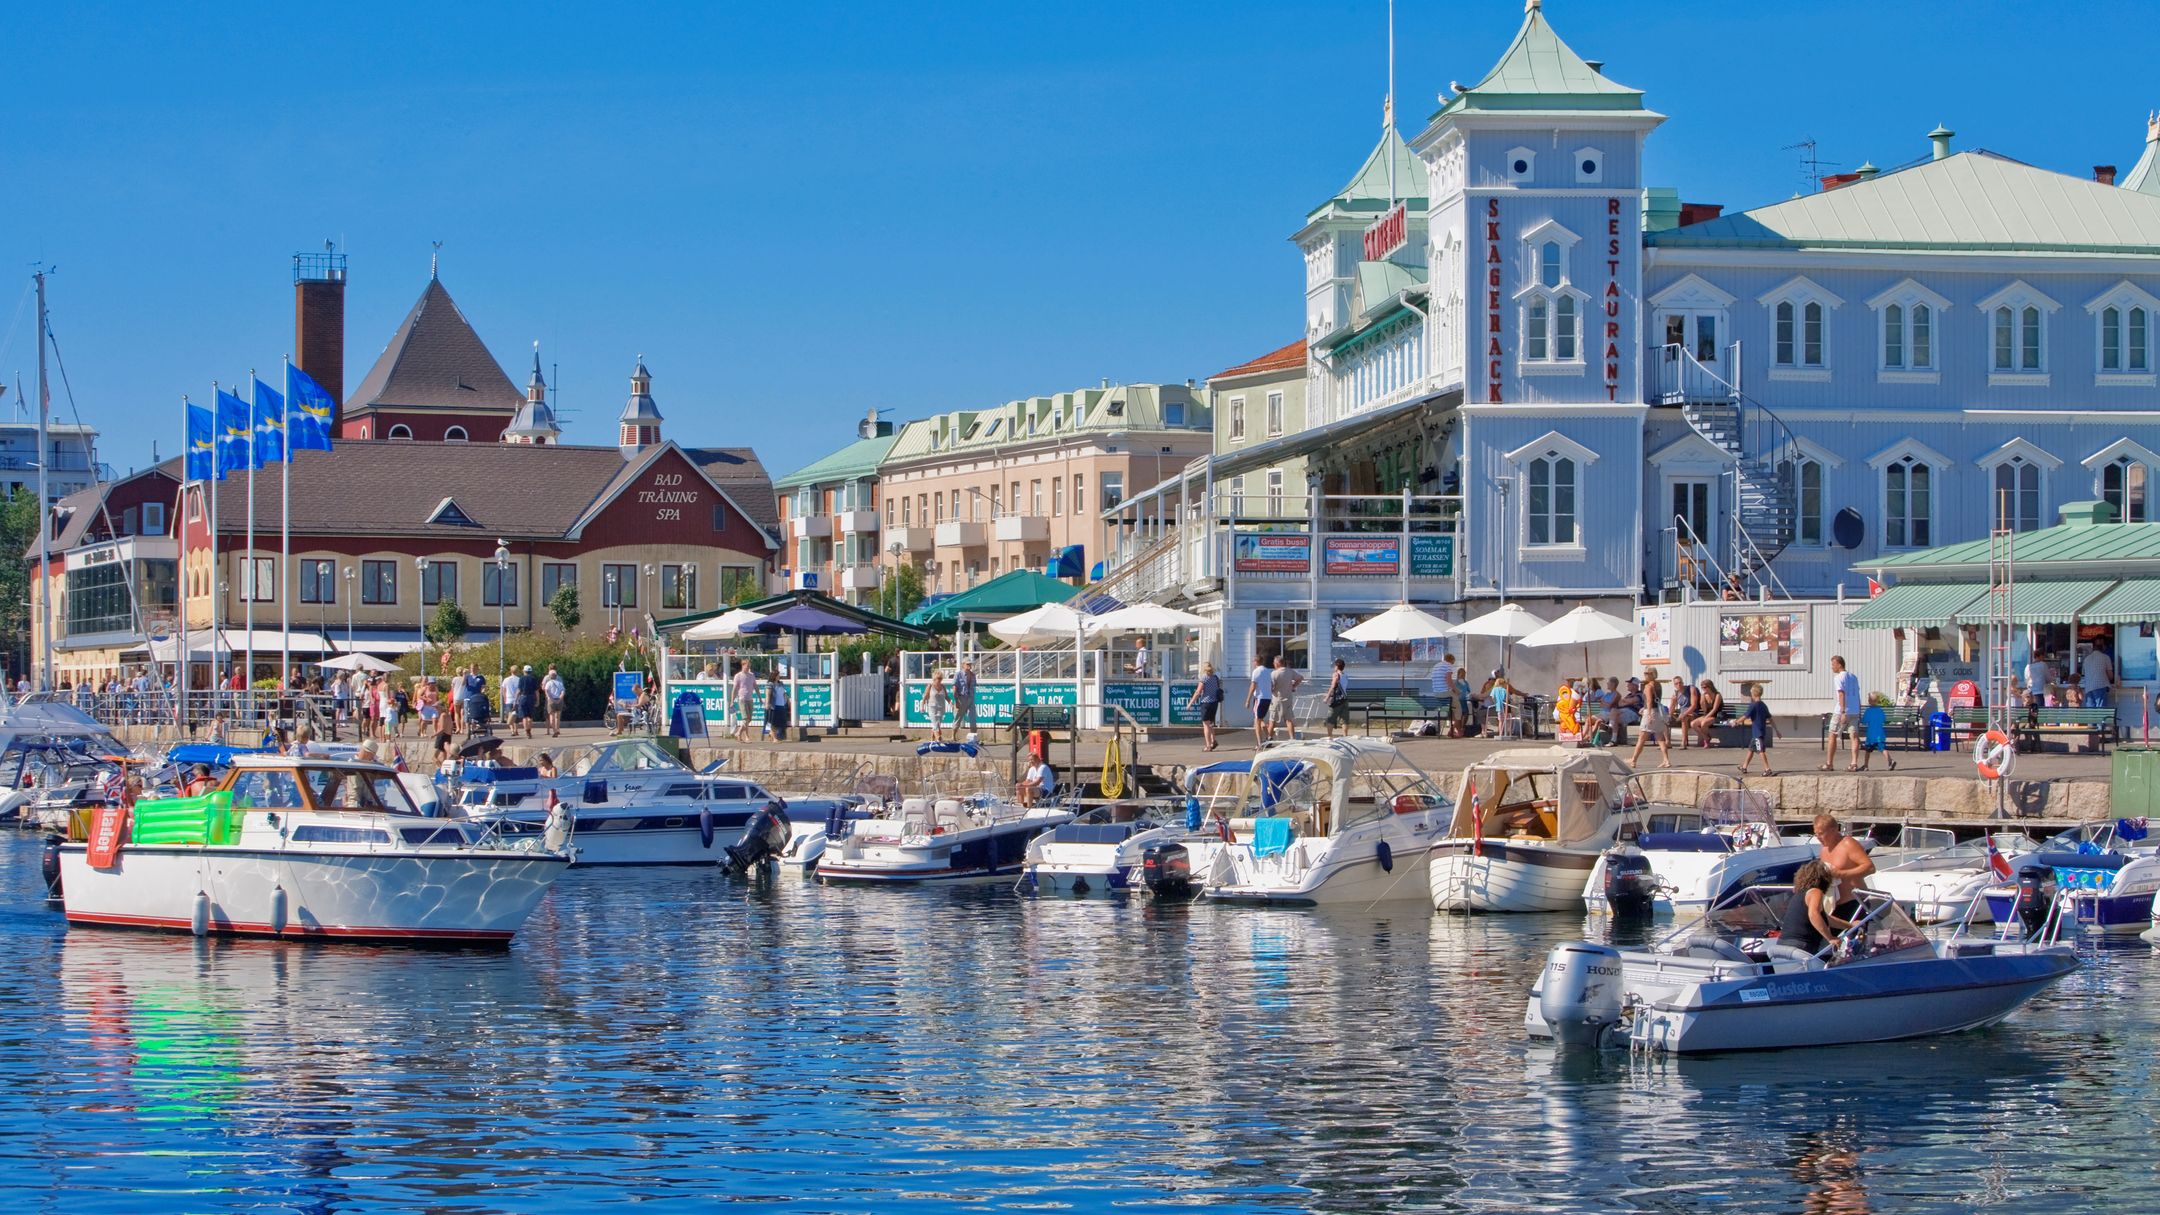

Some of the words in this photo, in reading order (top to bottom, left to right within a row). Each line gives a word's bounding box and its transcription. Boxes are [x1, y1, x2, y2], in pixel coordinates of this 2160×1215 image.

[1487, 199, 1503, 403] SKAGERACK
[1606, 199, 1620, 401] RESTAURANT
[654, 474, 682, 486] BAD
[638, 489, 698, 503] TRÄNING
[656, 508, 681, 520] SPA
[1260, 538, 1285, 546] Gratis
[1286, 538, 1307, 546] buss!
[1329, 541, 1395, 550] Sommarshopping!
[1550, 962, 1567, 972] 115
[1586, 965, 1622, 977] HOND
[1766, 981, 1811, 998] Buster
